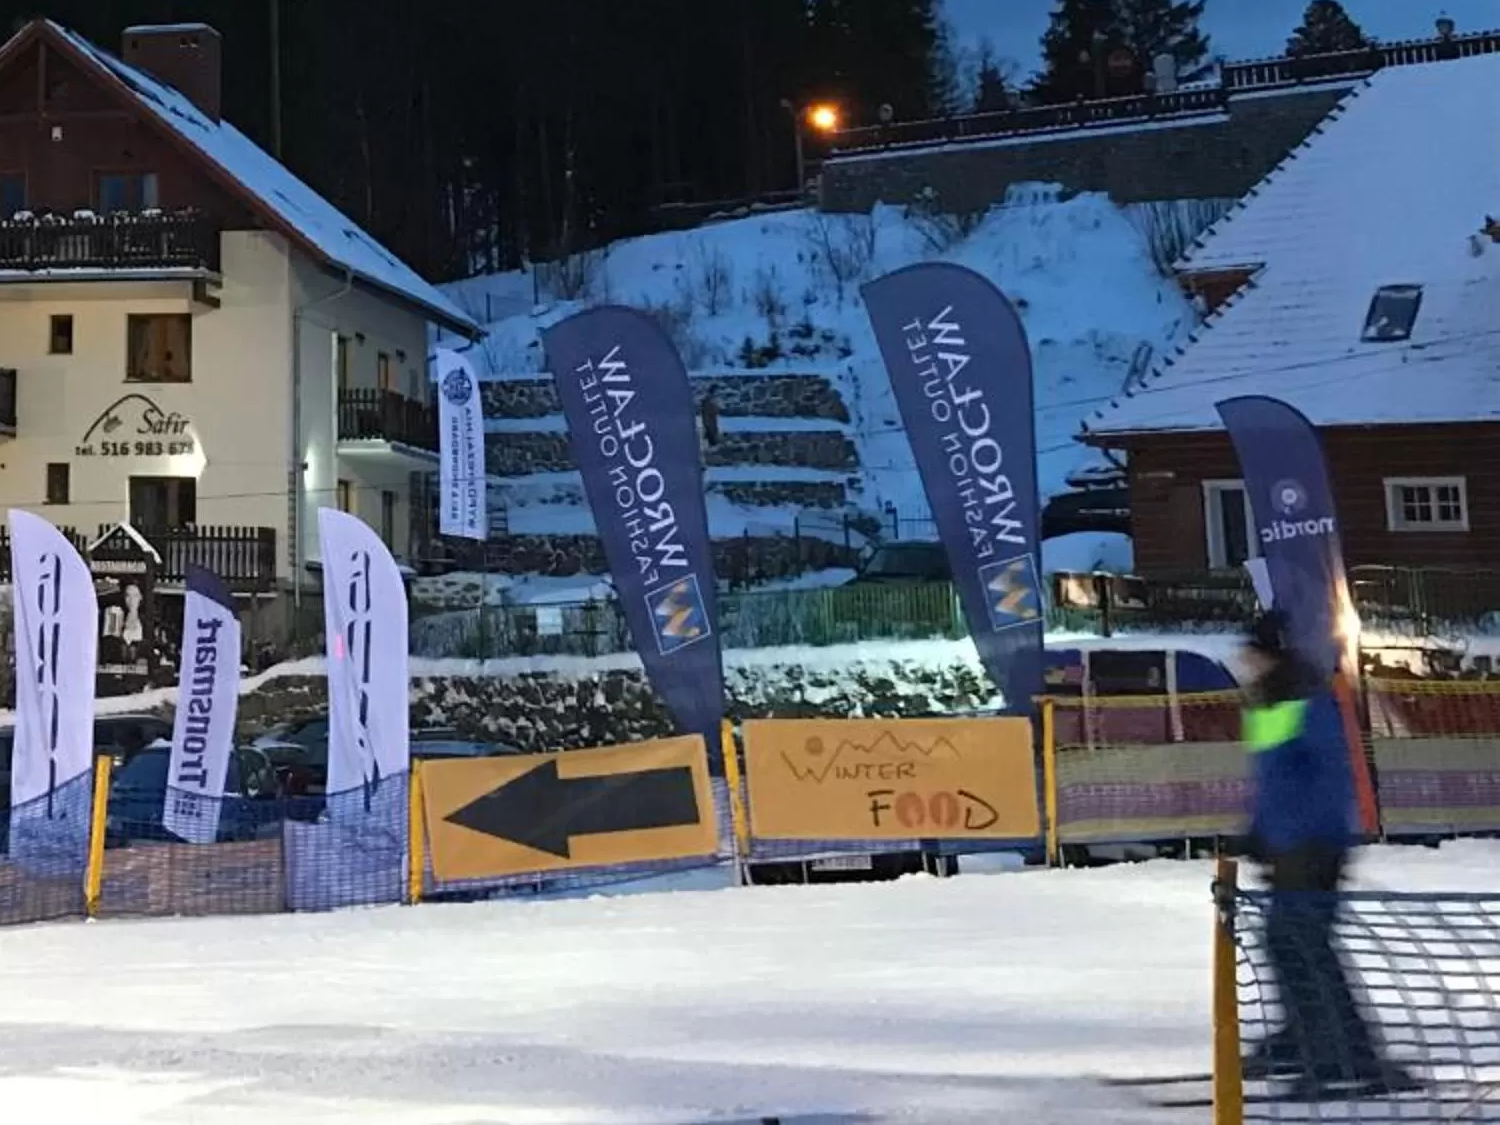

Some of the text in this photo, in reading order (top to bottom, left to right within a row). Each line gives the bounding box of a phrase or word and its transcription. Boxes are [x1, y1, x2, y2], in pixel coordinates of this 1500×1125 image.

[101, 440, 130, 456] 516
[134, 440, 163, 456] 983
[866, 788, 1000, 831] FOOD
